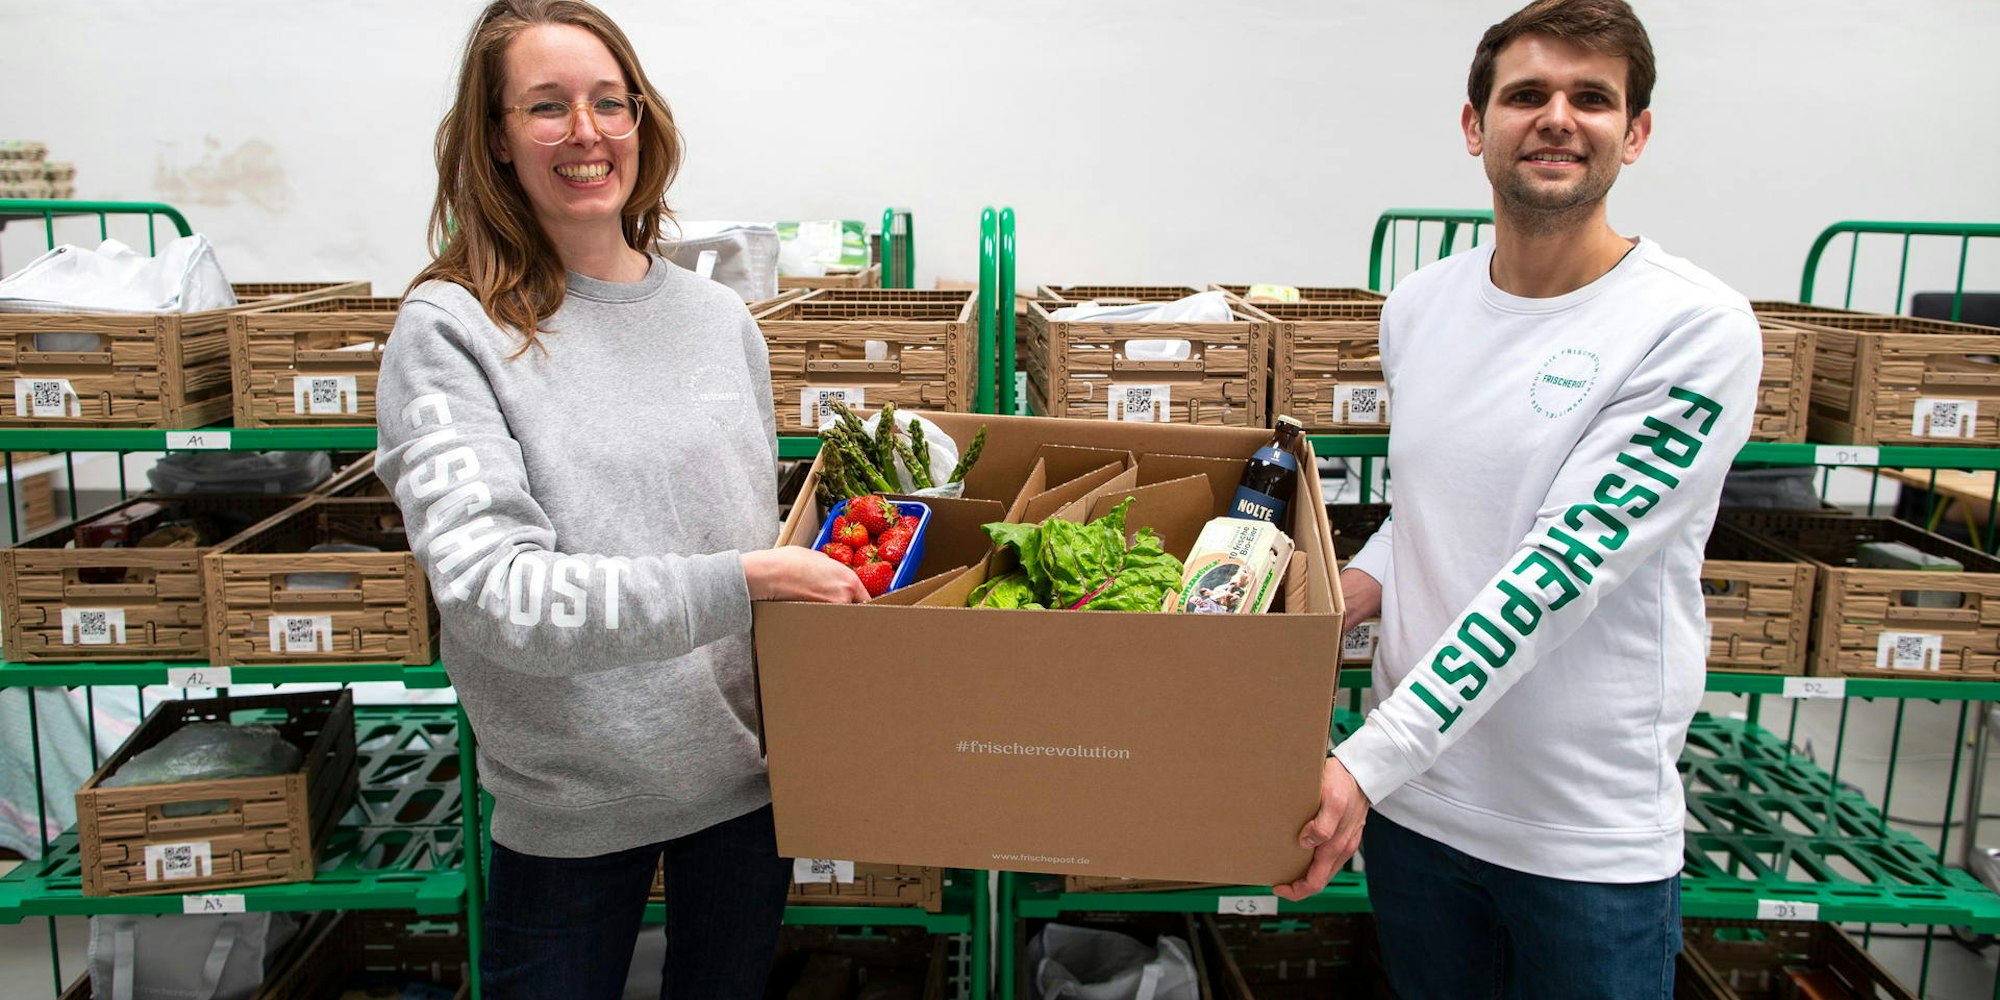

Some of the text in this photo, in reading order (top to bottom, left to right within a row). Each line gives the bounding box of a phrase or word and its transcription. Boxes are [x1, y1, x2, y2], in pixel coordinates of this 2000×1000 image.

[186, 435, 205, 447] A1
[1272, 450, 1281, 459] N
[1236, 498, 1274, 522] NOLTE
[1232, 526, 1251, 551] frische
[1239, 526, 1259, 557] Bio-Eier
[1228, 550, 1238, 560] 10
[1408, 386, 1724, 734] FRISCHEPOST
[186, 672, 211, 685] A2
[1803, 681, 1829, 694] D2
[956, 740, 1131, 760] #frischerevolution
[991, 852, 1091, 865] www.frischepost.de
[204, 897, 223, 911] A3
[1775, 904, 1797, 918] D3
